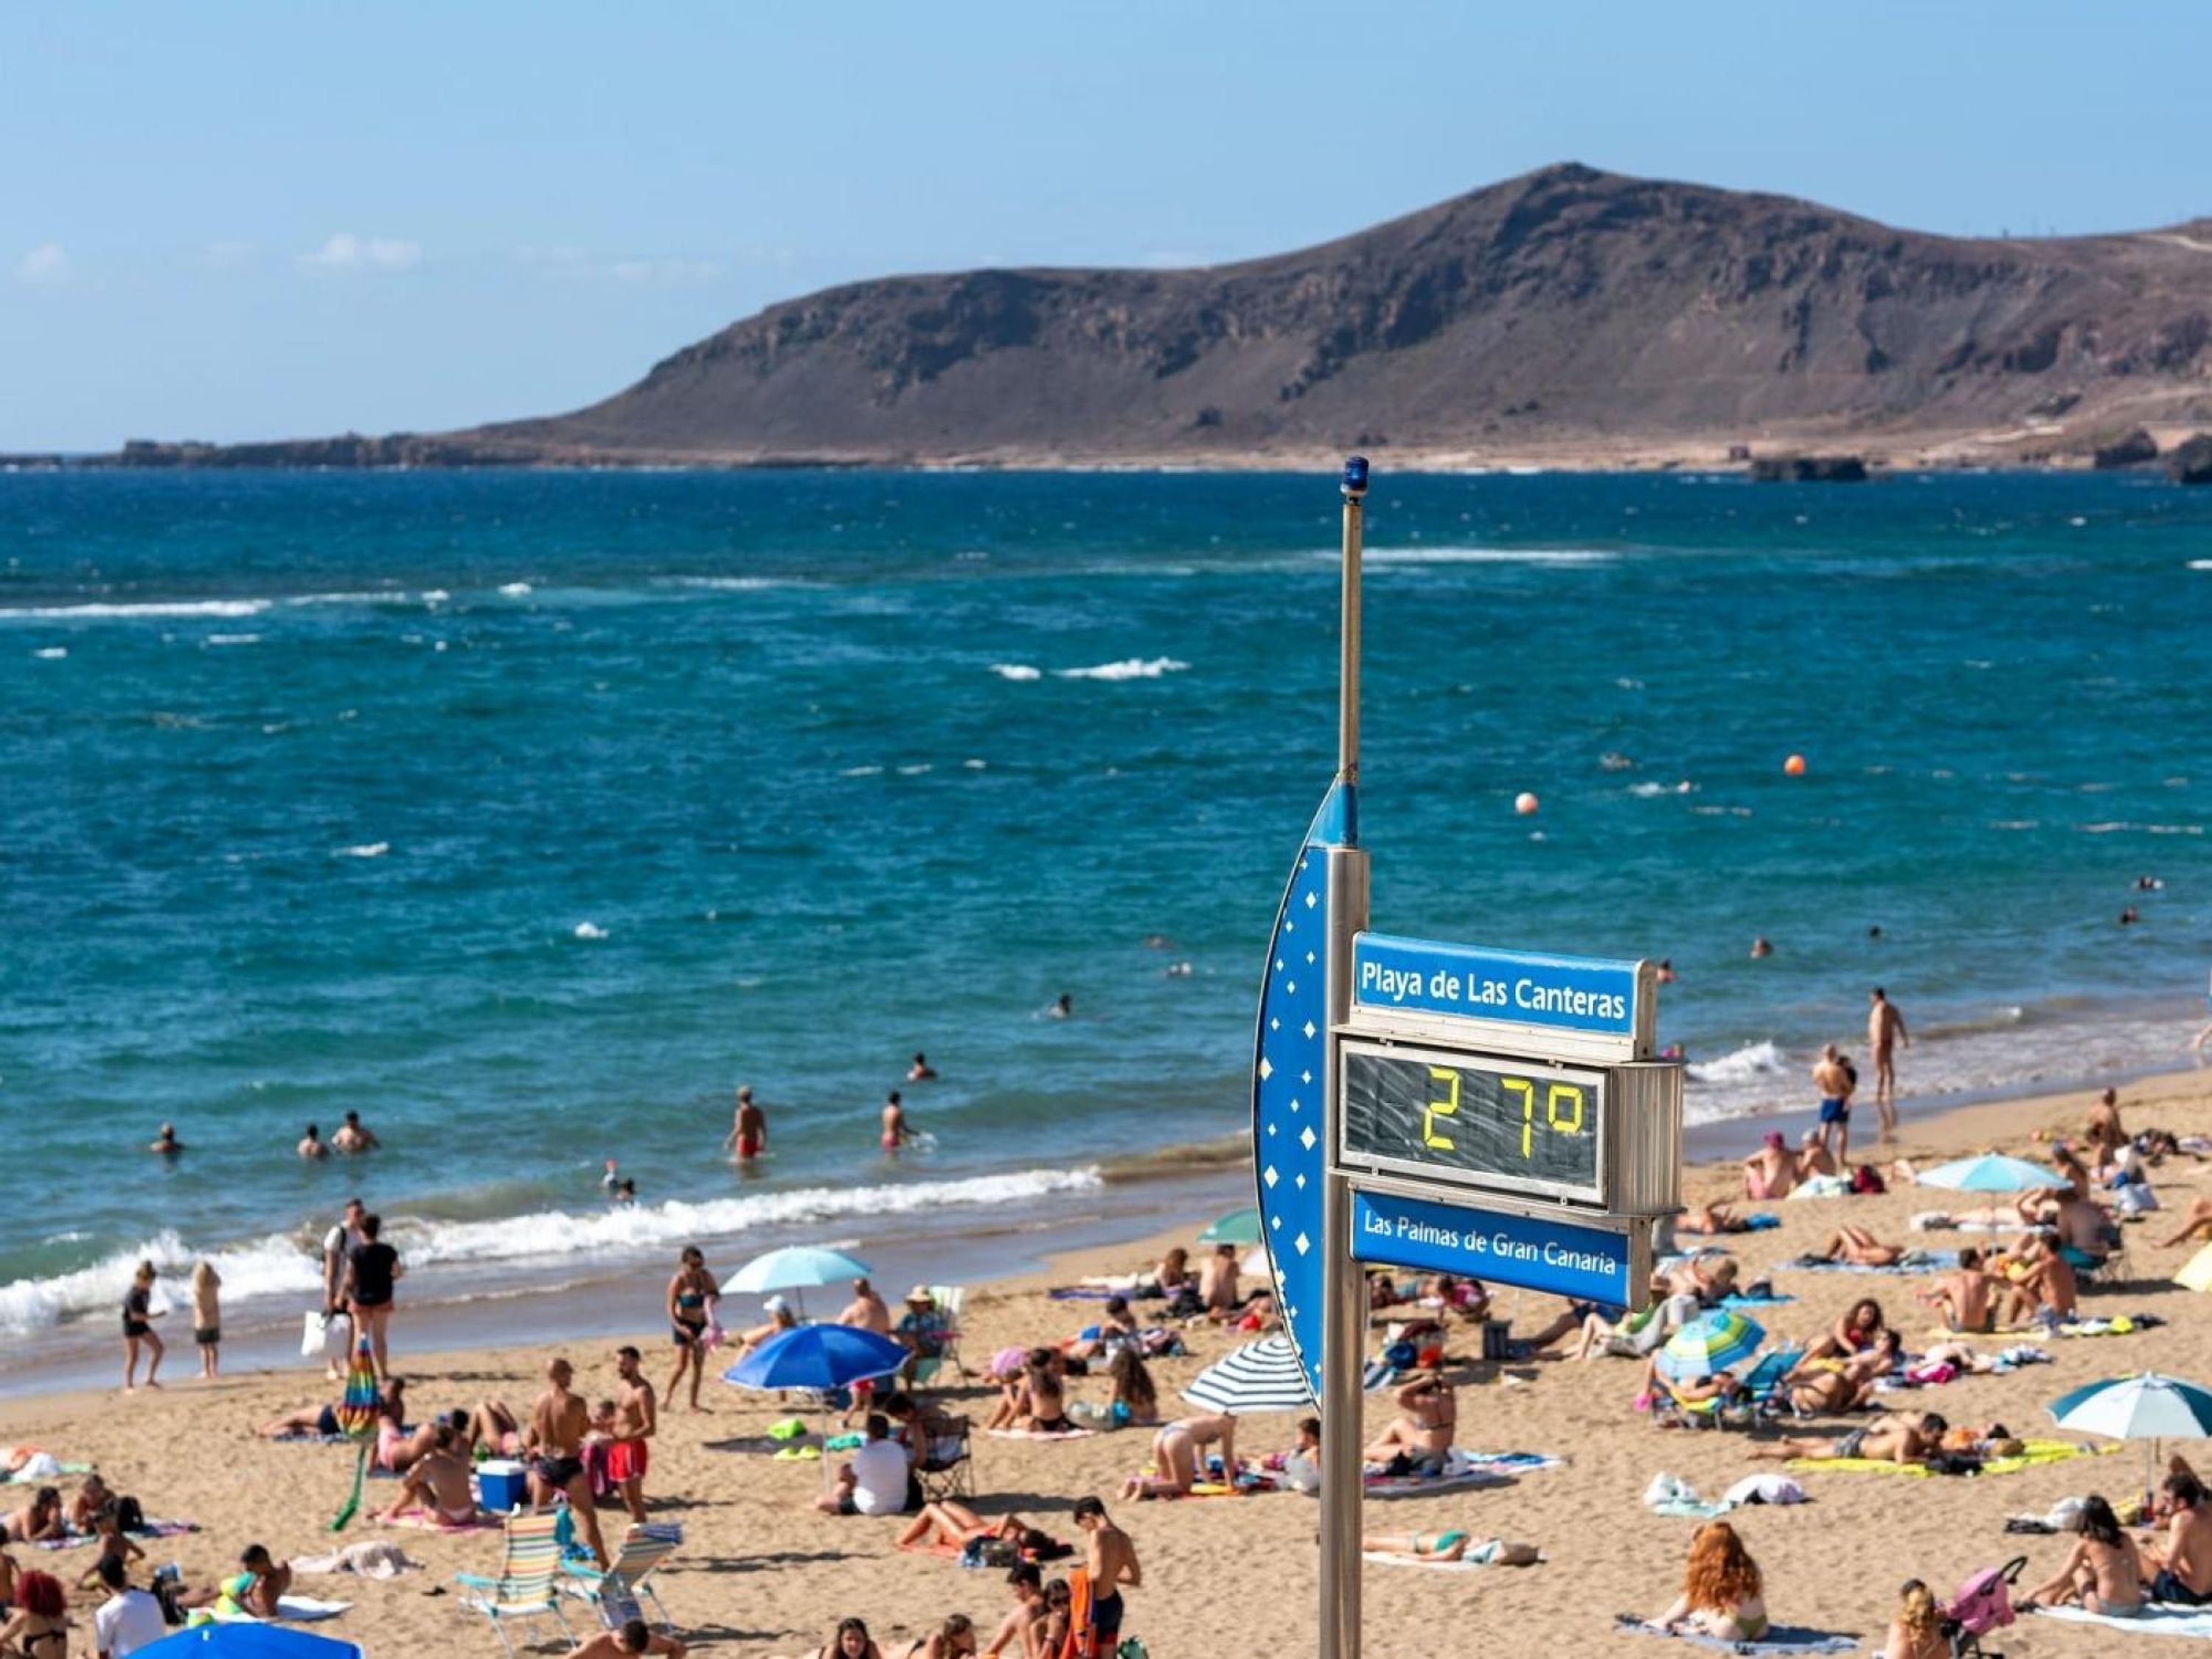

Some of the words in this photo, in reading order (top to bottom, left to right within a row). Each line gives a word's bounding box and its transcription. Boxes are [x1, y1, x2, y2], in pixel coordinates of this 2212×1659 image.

[1362, 961, 1422, 1001] Playa
[1430, 970, 1461, 1000] de
[1467, 973, 1507, 1006] Las
[1514, 978, 1626, 1020] Canteras
[1364, 1210, 1392, 1237] Las
[1464, 1230, 1488, 1253] de
[1492, 1233, 1539, 1262] Gran
[1544, 1242, 1616, 1276] Canaria
